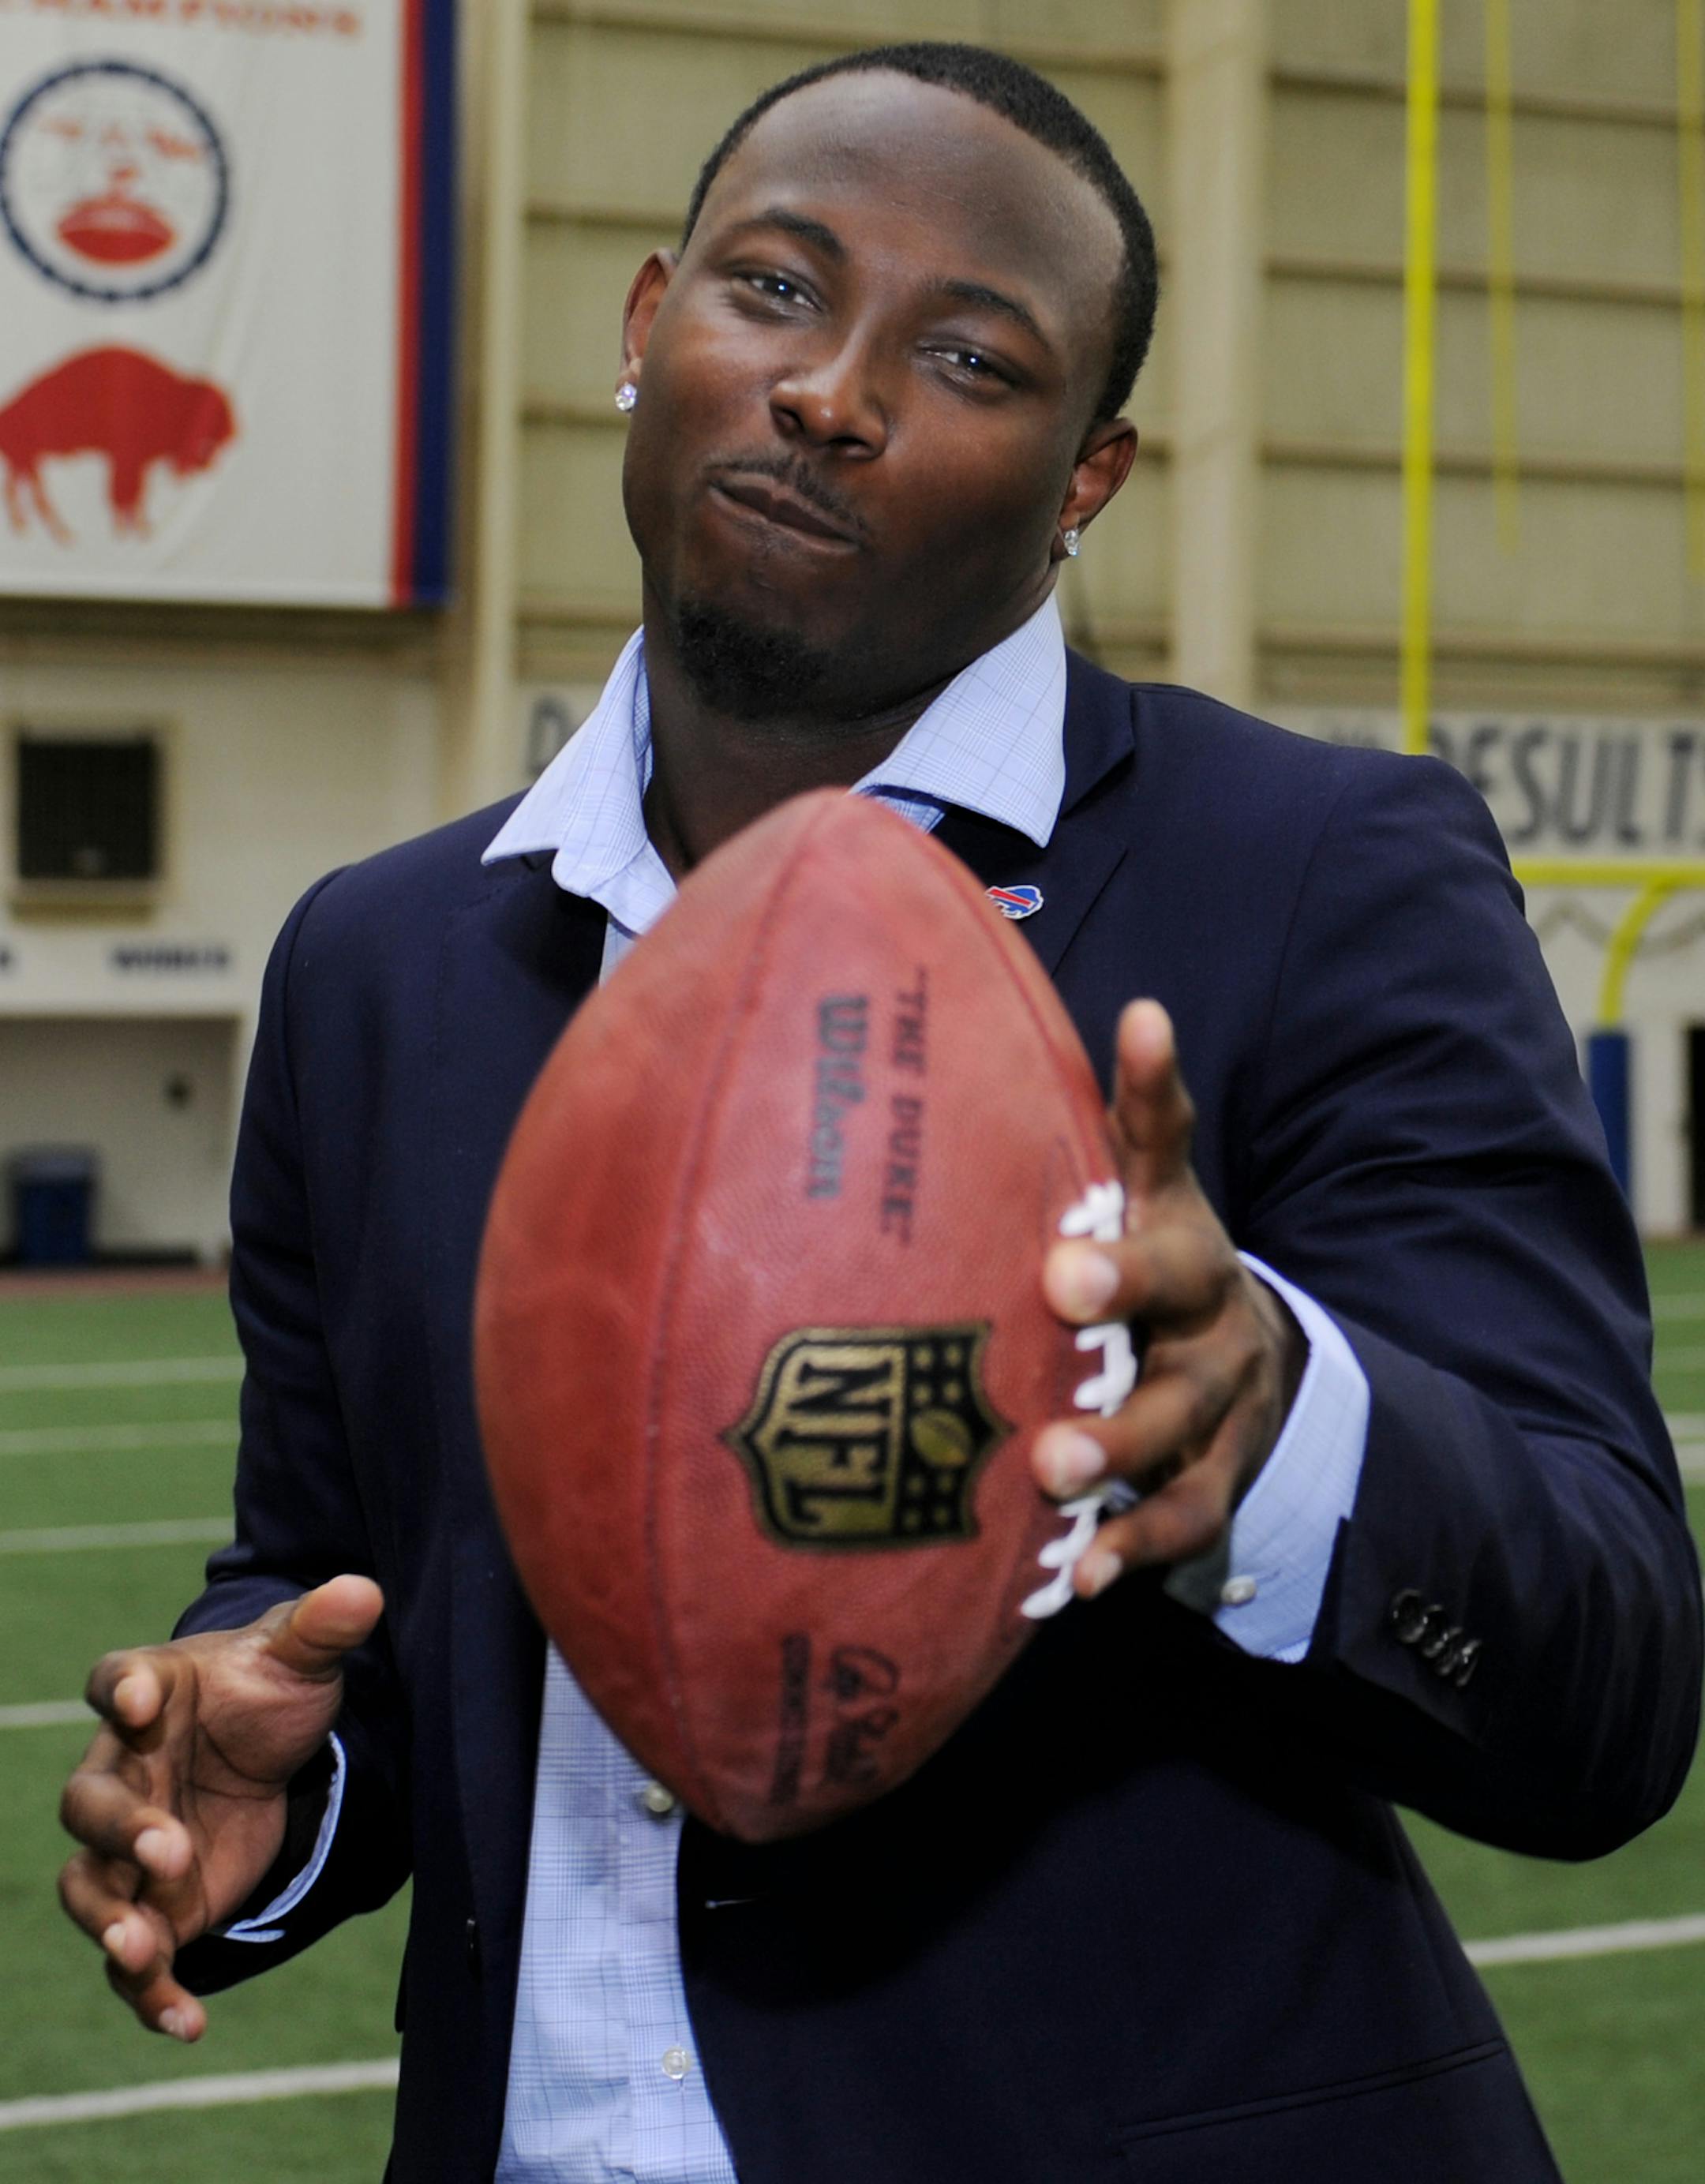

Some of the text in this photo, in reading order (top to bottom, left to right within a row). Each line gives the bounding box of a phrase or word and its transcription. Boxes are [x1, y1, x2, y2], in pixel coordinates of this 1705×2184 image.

[1427, 720, 1705, 848] ESULT
[808, 994, 868, 1200] Wilson
[774, 1359, 894, 1523] NFL
